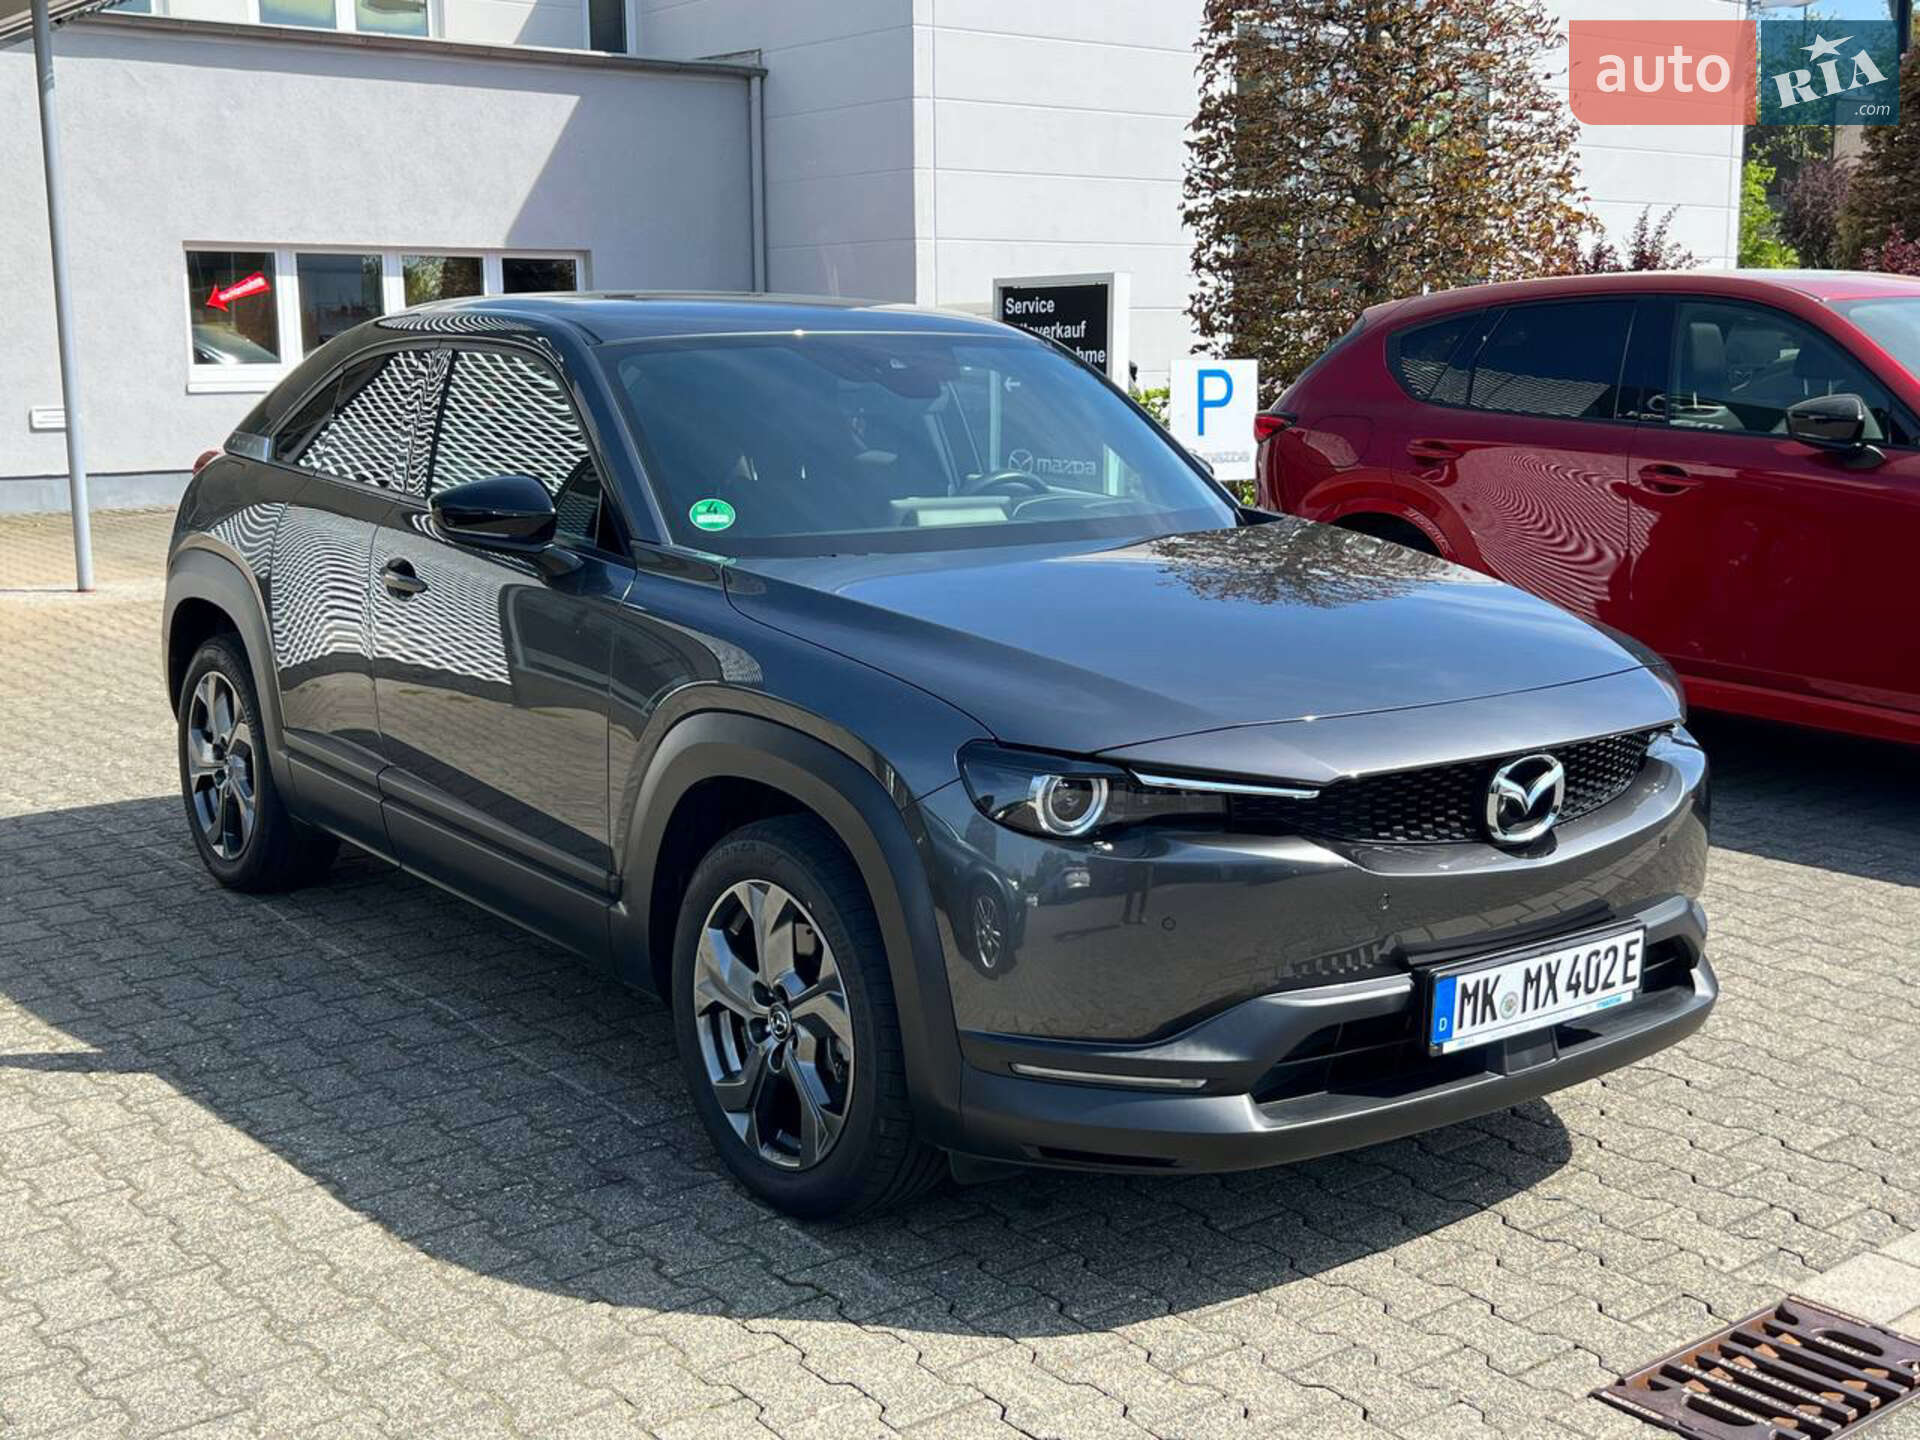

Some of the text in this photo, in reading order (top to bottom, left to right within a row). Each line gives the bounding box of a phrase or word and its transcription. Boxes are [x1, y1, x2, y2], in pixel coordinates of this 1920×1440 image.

[1005, 296, 1055, 315] Service
[1196, 368, 1234, 437] P
[1457, 938, 1641, 1030] MK MX 402E
[1438, 1016, 1448, 1032] D
